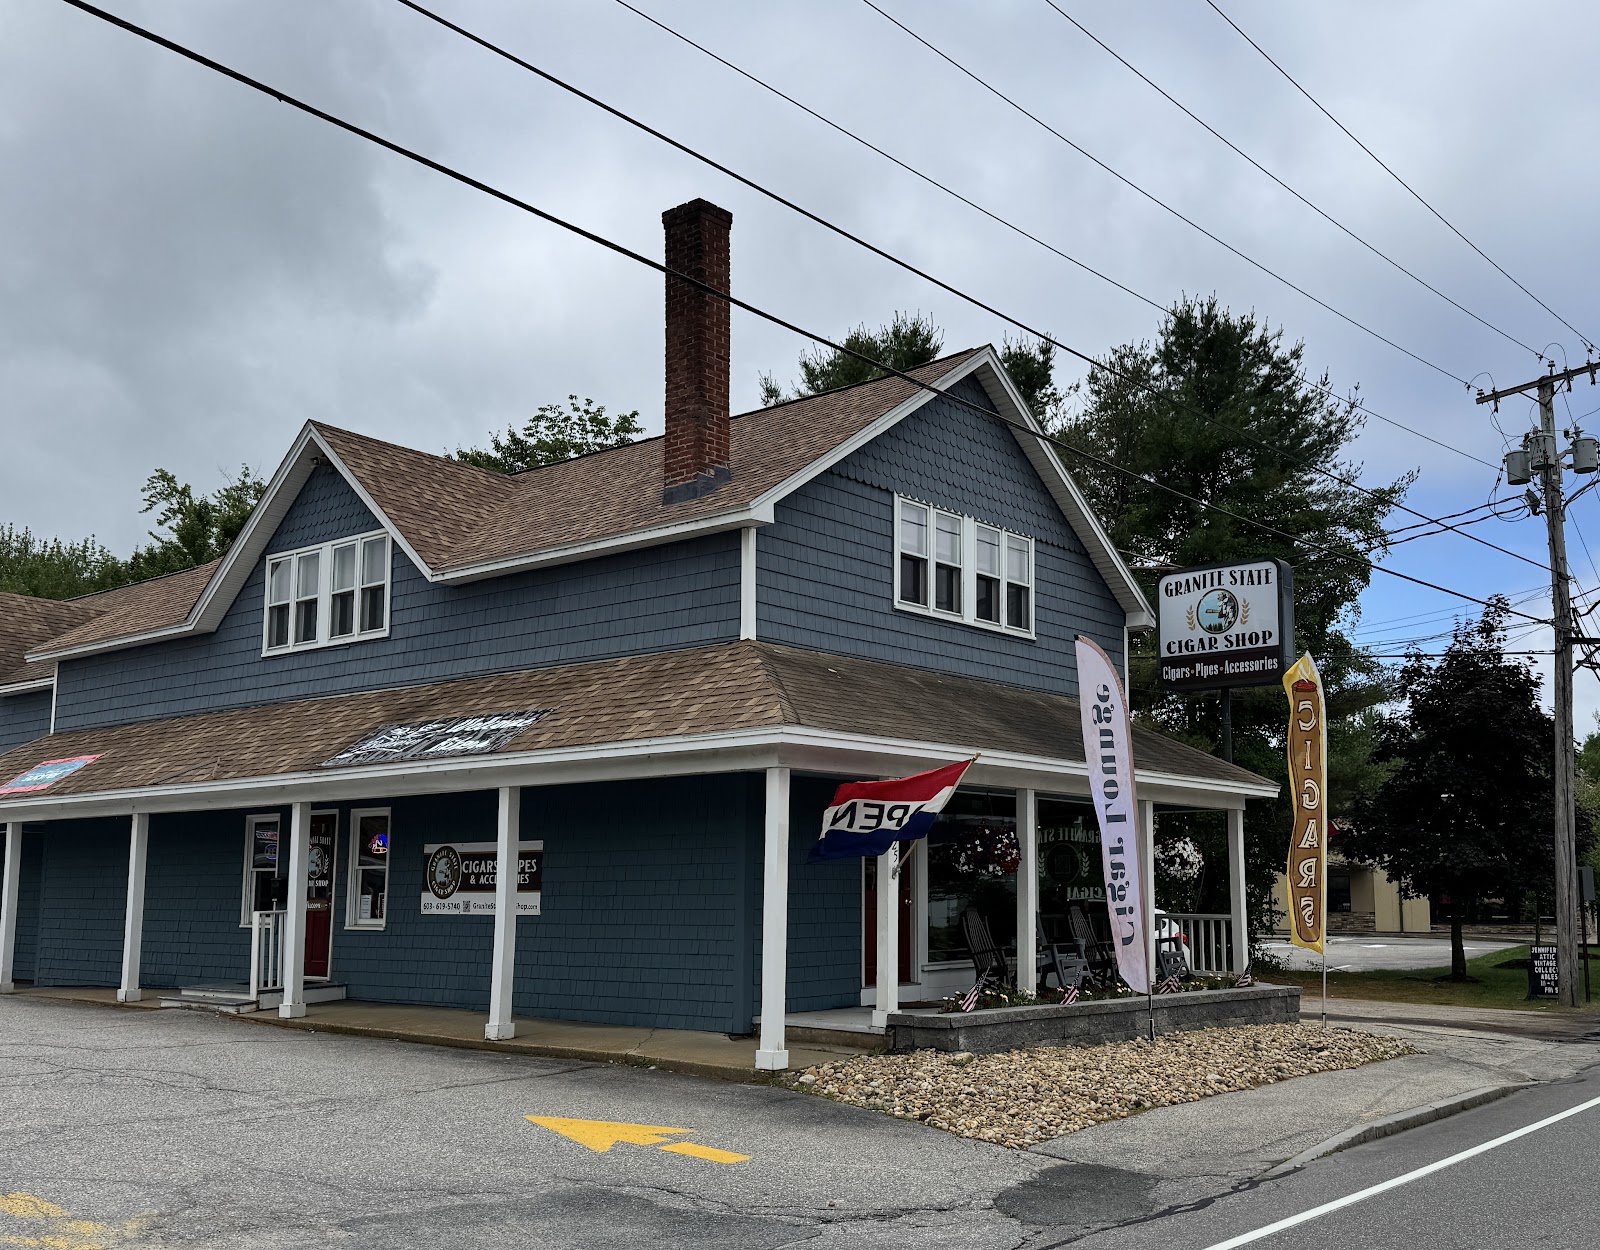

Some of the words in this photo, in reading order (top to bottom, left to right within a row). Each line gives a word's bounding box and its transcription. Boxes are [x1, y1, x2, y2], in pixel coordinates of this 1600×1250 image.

[1164, 570, 1225, 598] GRANITE
[1229, 568, 1273, 586] STATE
[1166, 636, 1218, 655] CIGAR
[1224, 630, 1273, 648] SHOP
[1162, 665, 1194, 681] Cigars
[1195, 662, 1219, 679] Pipes
[1224, 656, 1278, 675] Accessories
[469, 875, 477, 885] &
